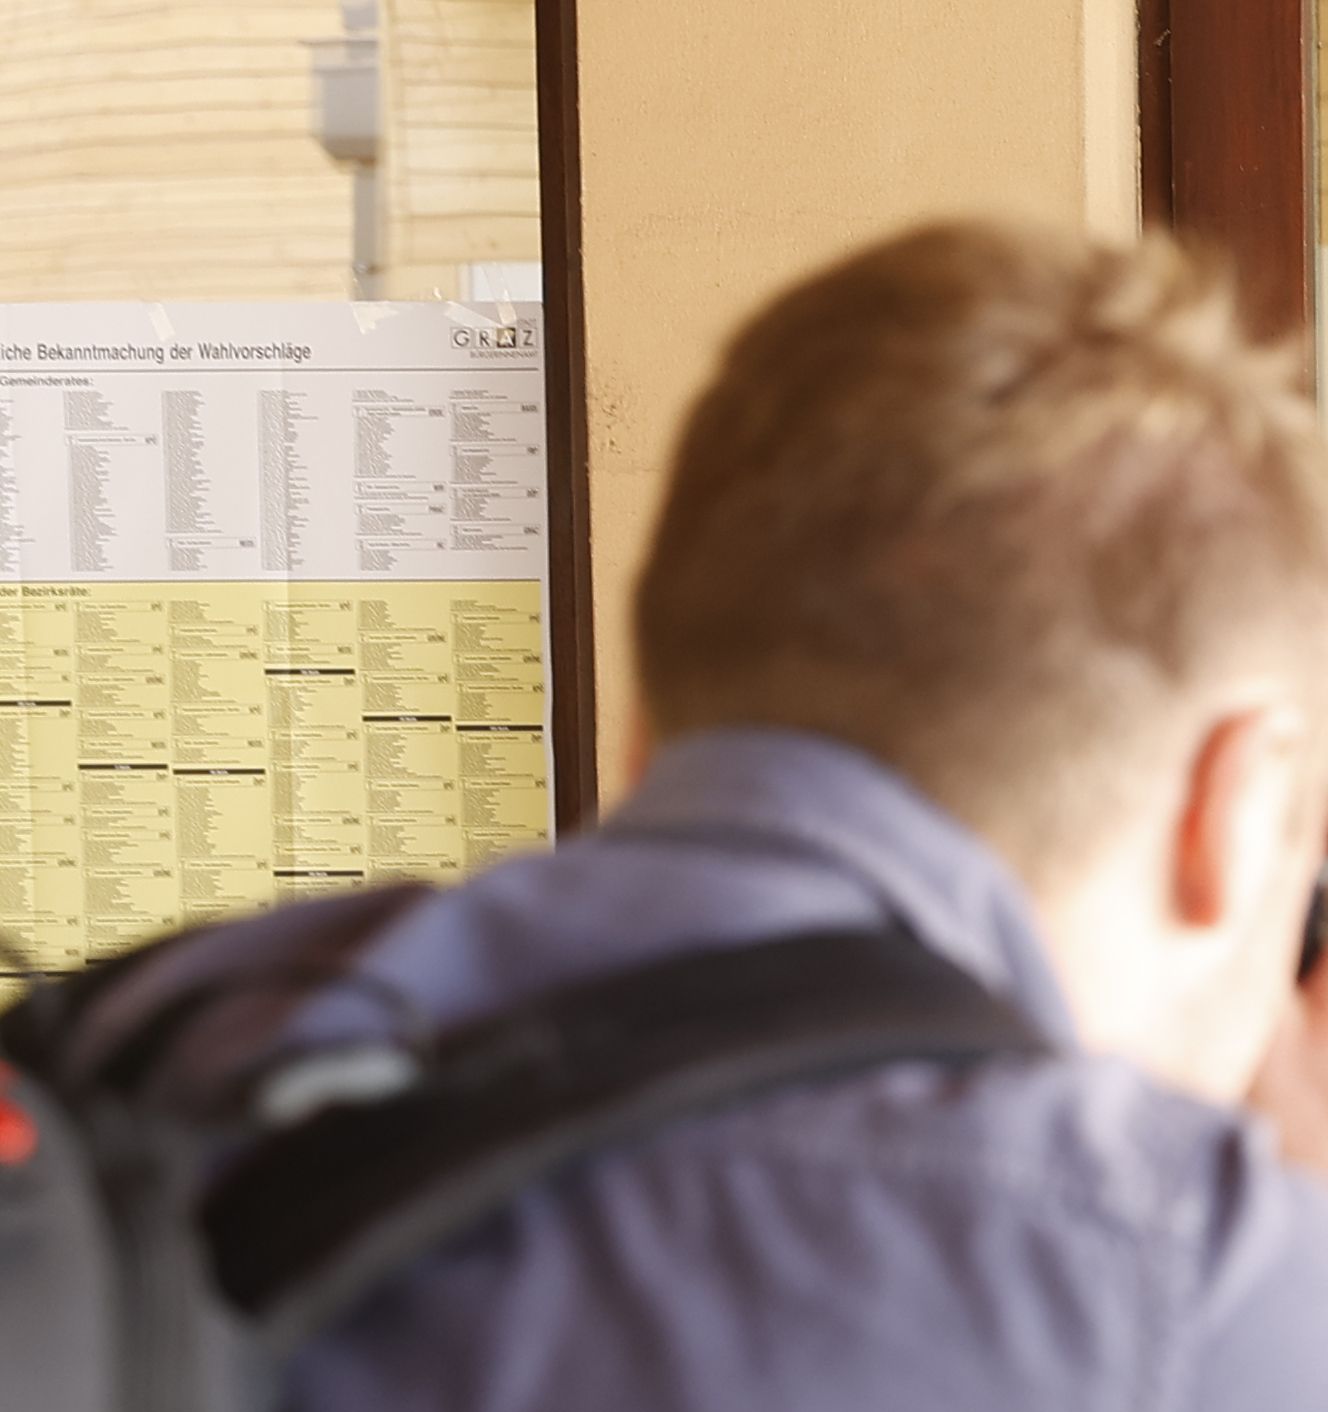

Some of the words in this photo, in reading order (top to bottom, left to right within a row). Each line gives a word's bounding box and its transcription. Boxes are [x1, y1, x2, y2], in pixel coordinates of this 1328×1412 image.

[453, 328, 534, 347] GRAZ
[38, 343, 164, 363] Bekanntmachung
[170, 342, 192, 360] der
[199, 341, 312, 363] Wahlvorschläge
[0, 375, 94, 388] Gemeinderates:
